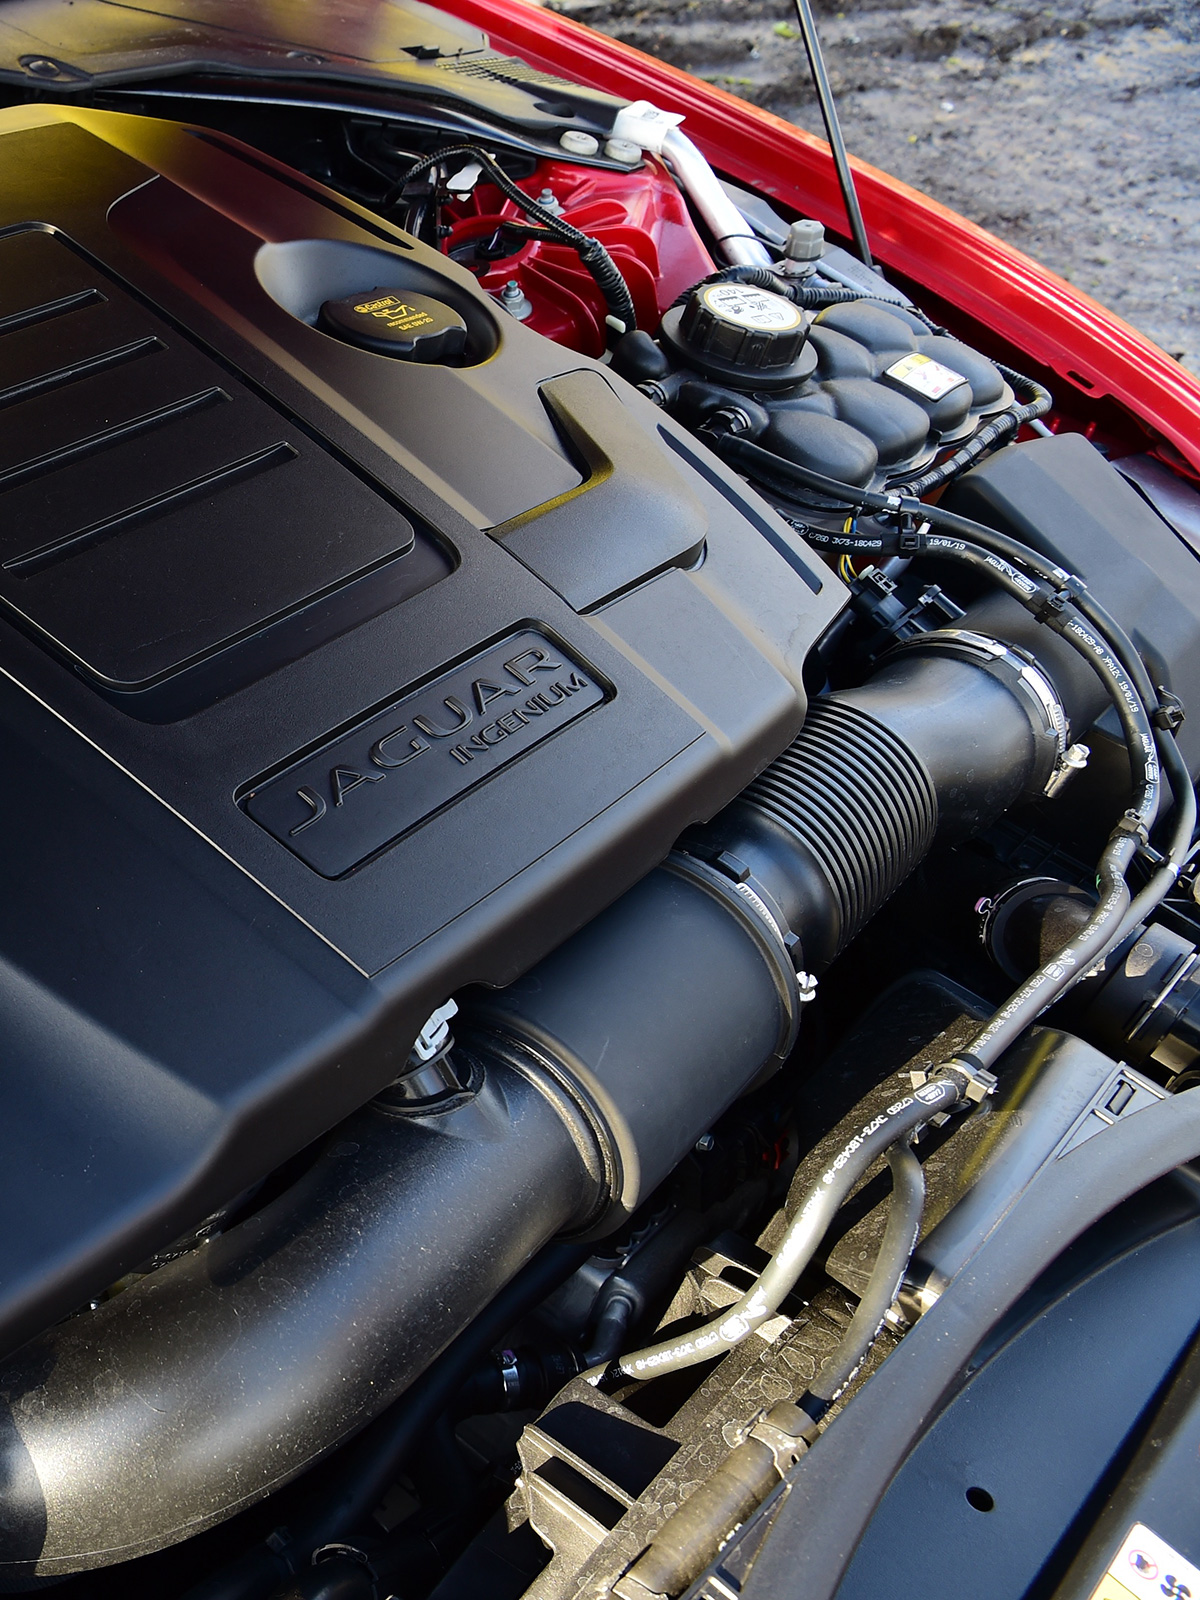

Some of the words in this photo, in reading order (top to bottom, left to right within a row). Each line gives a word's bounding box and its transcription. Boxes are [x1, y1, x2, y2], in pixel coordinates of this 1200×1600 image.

[364, 299, 394, 311] Castrol
[928, 537, 967, 551] 19/01/19
[1117, 680, 1140, 714] 19/01/19
[448, 672, 590, 766] INGENIUM
[288, 646, 564, 837] JAGUAR
